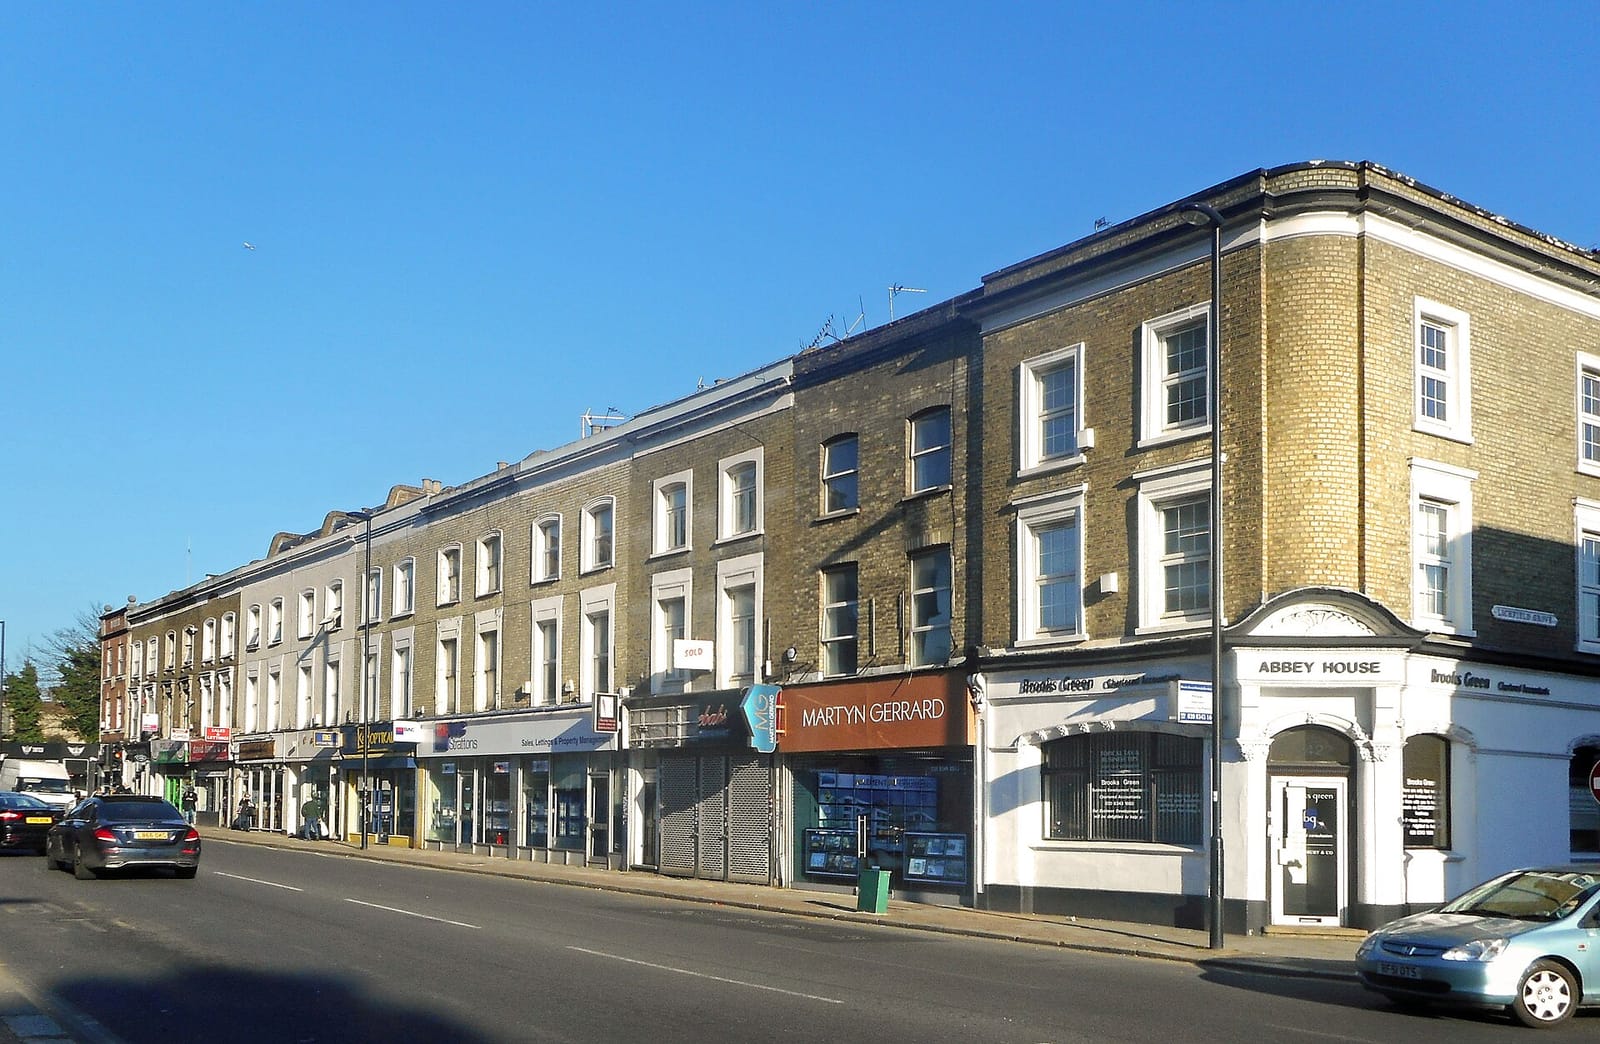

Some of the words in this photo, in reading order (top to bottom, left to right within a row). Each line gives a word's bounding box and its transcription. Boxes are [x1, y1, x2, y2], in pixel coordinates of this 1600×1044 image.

[684, 647, 703, 657] SOLD
[1259, 662, 1314, 674] ABBEY
[1322, 662, 1381, 674] HOUSE
[1020, 678, 1057, 694] Brooks
[1059, 676, 1093, 692] Green
[1430, 669, 1462, 685] Brooks
[1463, 671, 1490, 689] Green
[802, 705, 866, 728] MARTYN
[869, 698, 945, 722] GERRARD
[559, 737, 578, 746] Property
[1312, 794, 1334, 804] green
